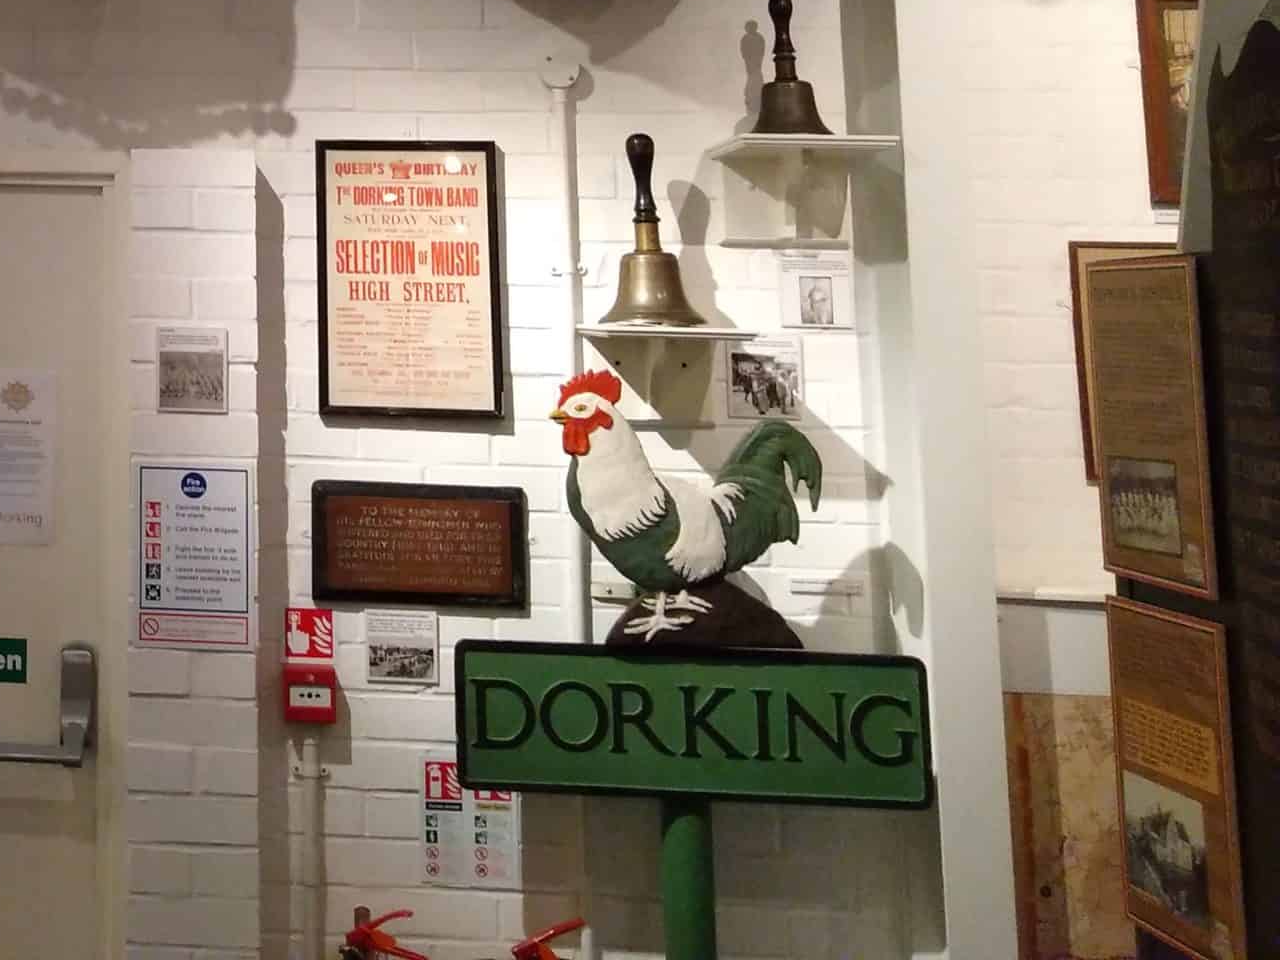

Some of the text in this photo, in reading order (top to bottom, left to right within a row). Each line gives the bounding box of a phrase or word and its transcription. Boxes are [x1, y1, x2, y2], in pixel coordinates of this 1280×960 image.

[335, 162, 477, 176] QUEEN'S BIRTAY
[408, 187, 443, 207] TOWN
[447, 187, 479, 208] BAND
[344, 215, 417, 225] SATURDAY
[336, 240, 480, 277] SELECTION OF MUSIC
[349, 281, 470, 305] HIGH STREET.
[186, 478, 201, 486] Fire
[469, 677, 919, 767] DORKING
